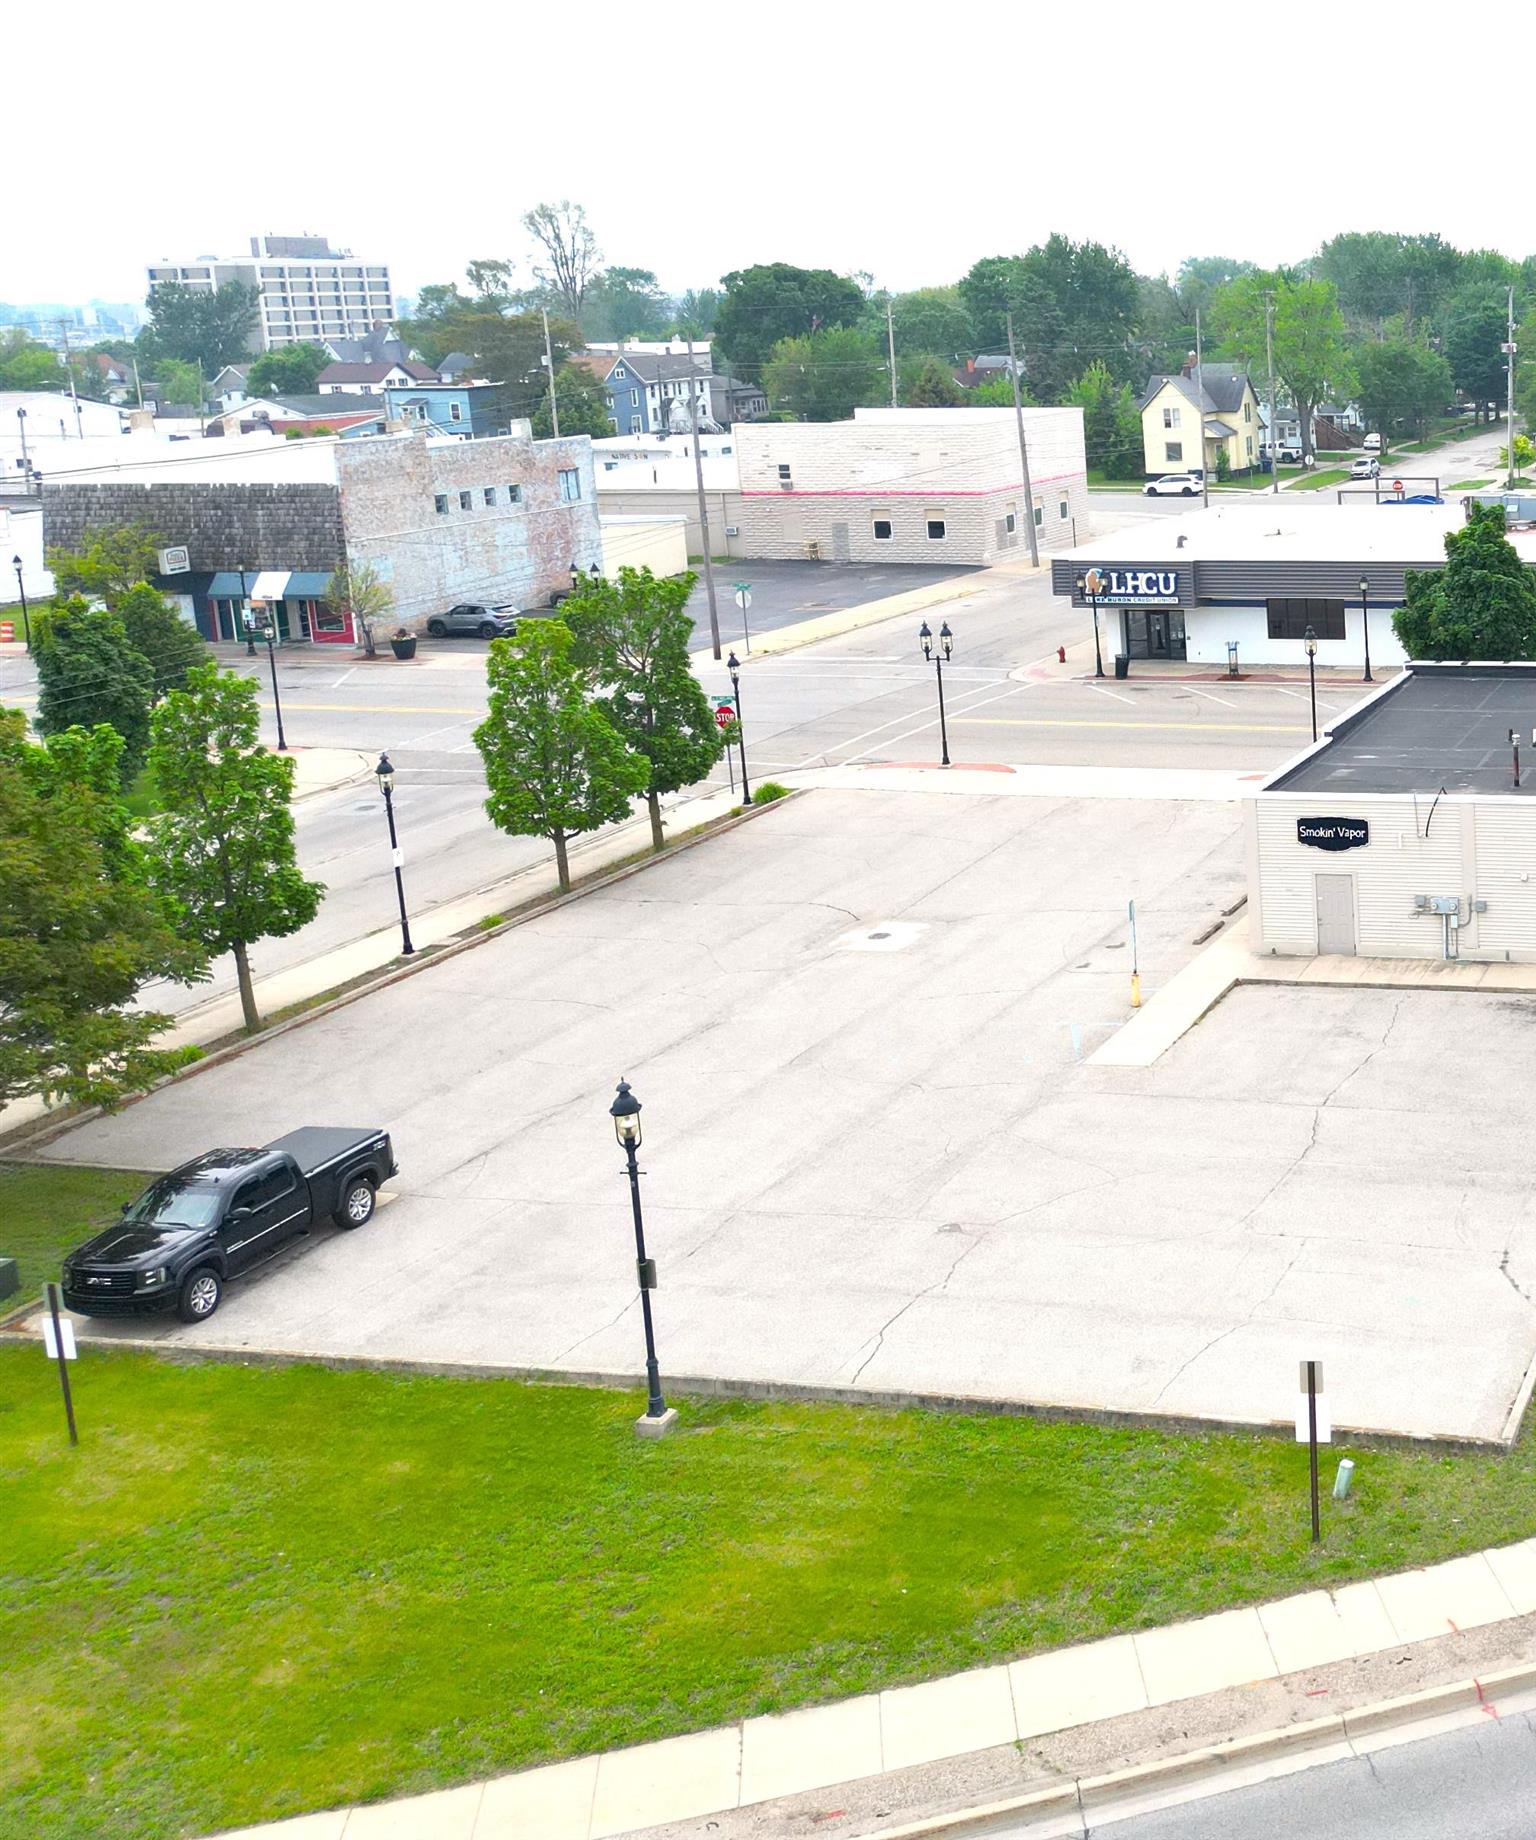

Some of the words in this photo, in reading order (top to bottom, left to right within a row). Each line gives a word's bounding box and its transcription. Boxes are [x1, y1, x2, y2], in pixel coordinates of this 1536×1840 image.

[1110, 572, 1176, 594] LHCU
[716, 713, 735, 722] STOP
[1299, 825, 1336, 838] Smokin'
[1337, 826, 1366, 840] Vapor
